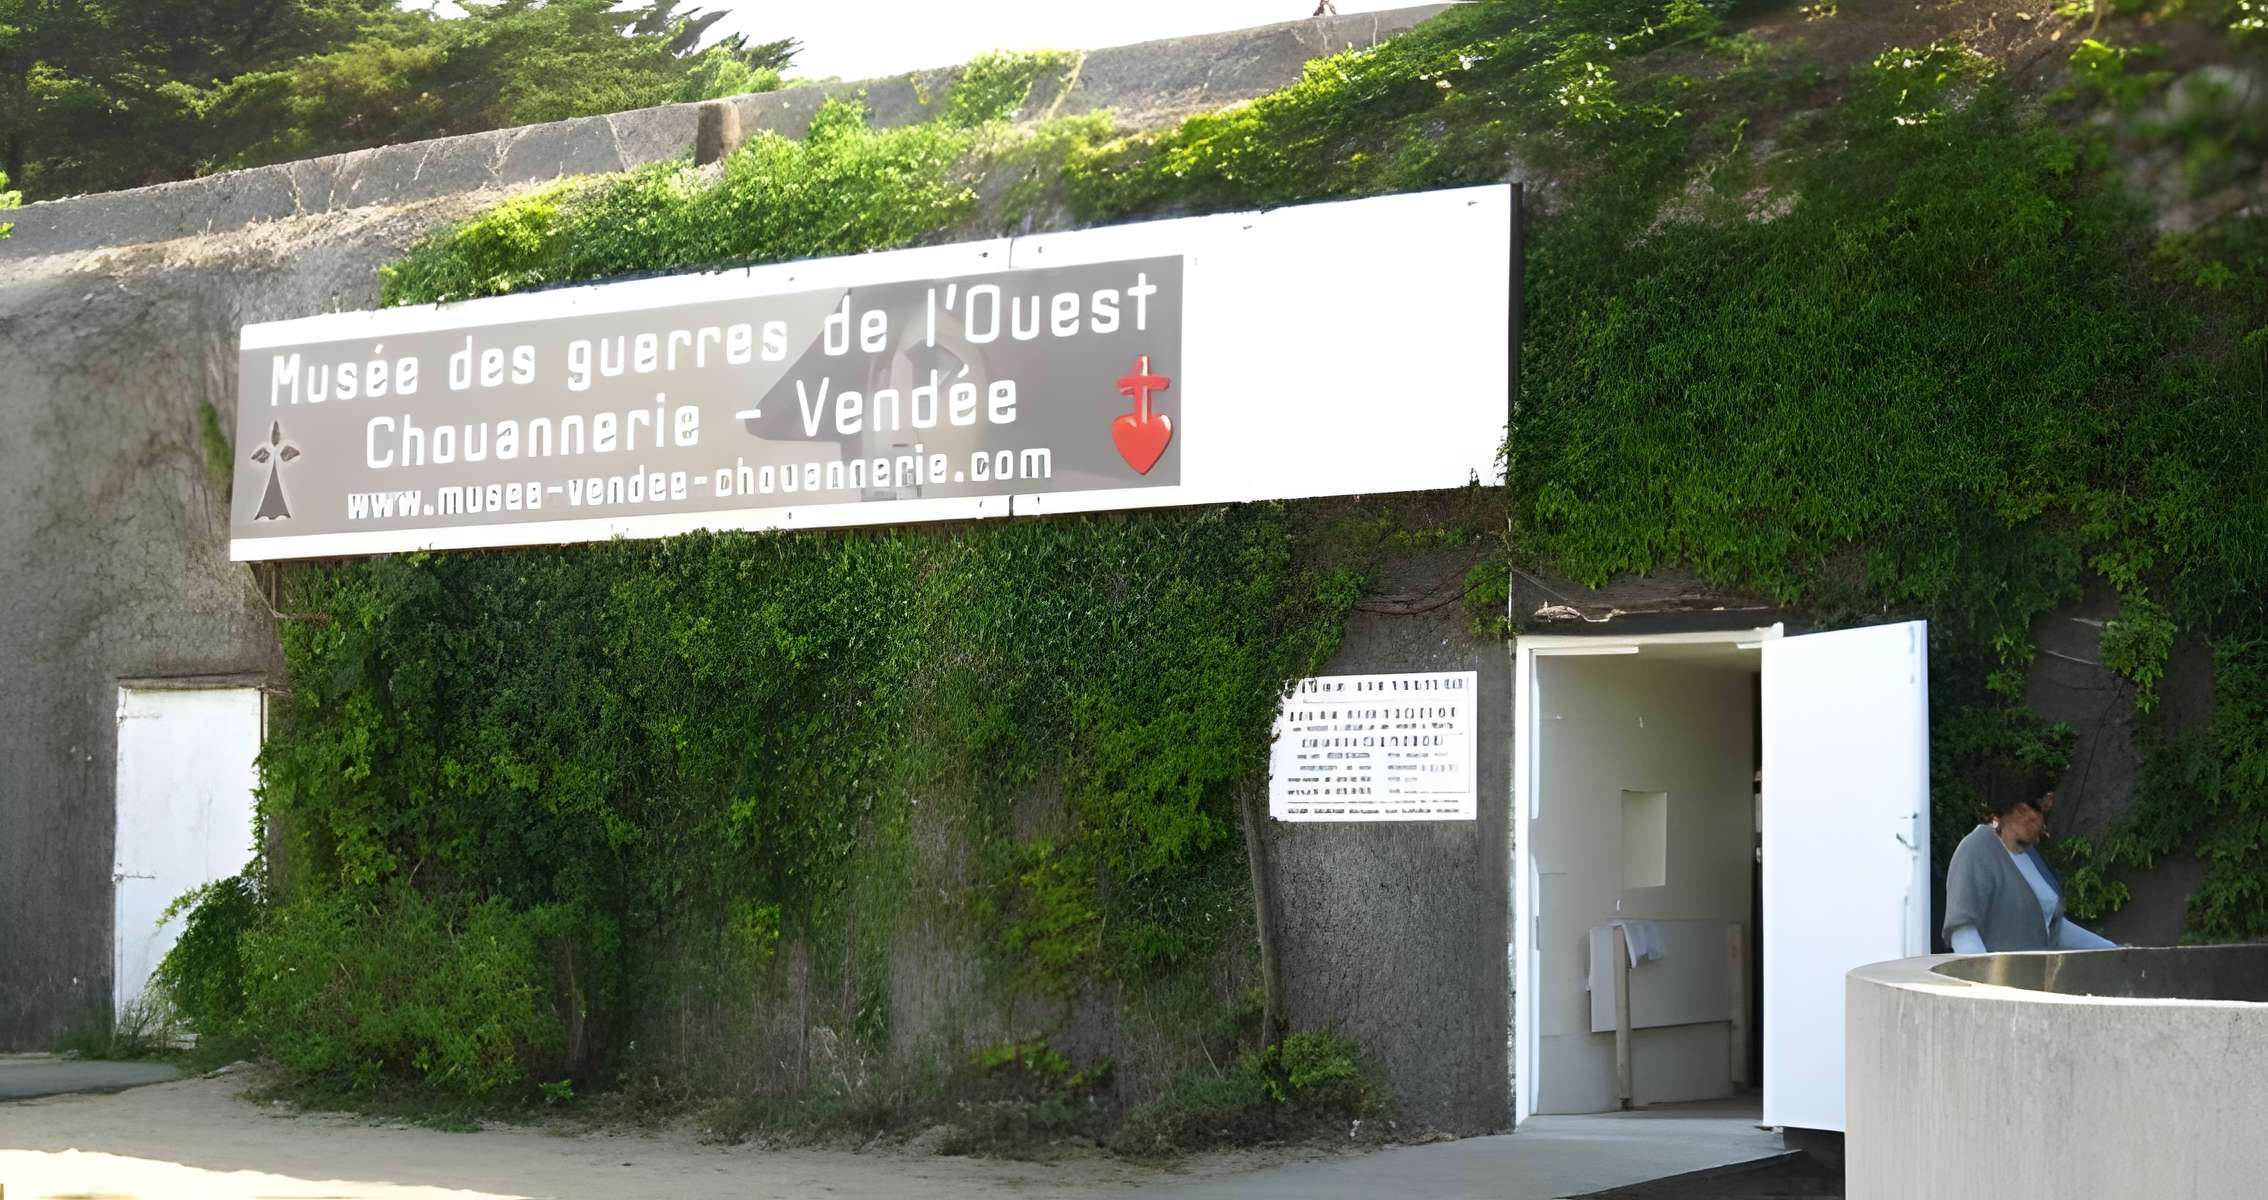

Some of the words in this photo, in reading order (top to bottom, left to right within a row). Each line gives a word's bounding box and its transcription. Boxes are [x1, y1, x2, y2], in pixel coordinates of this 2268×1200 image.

[271, 343, 419, 406] Musée
[448, 335, 536, 391] des
[567, 321, 788, 392] guerres
[823, 295, 887, 356] de
[926, 272, 1157, 348] l'Ouest
[366, 392, 699, 469] Chouannerie
[796, 363, 1017, 437] Vendée
